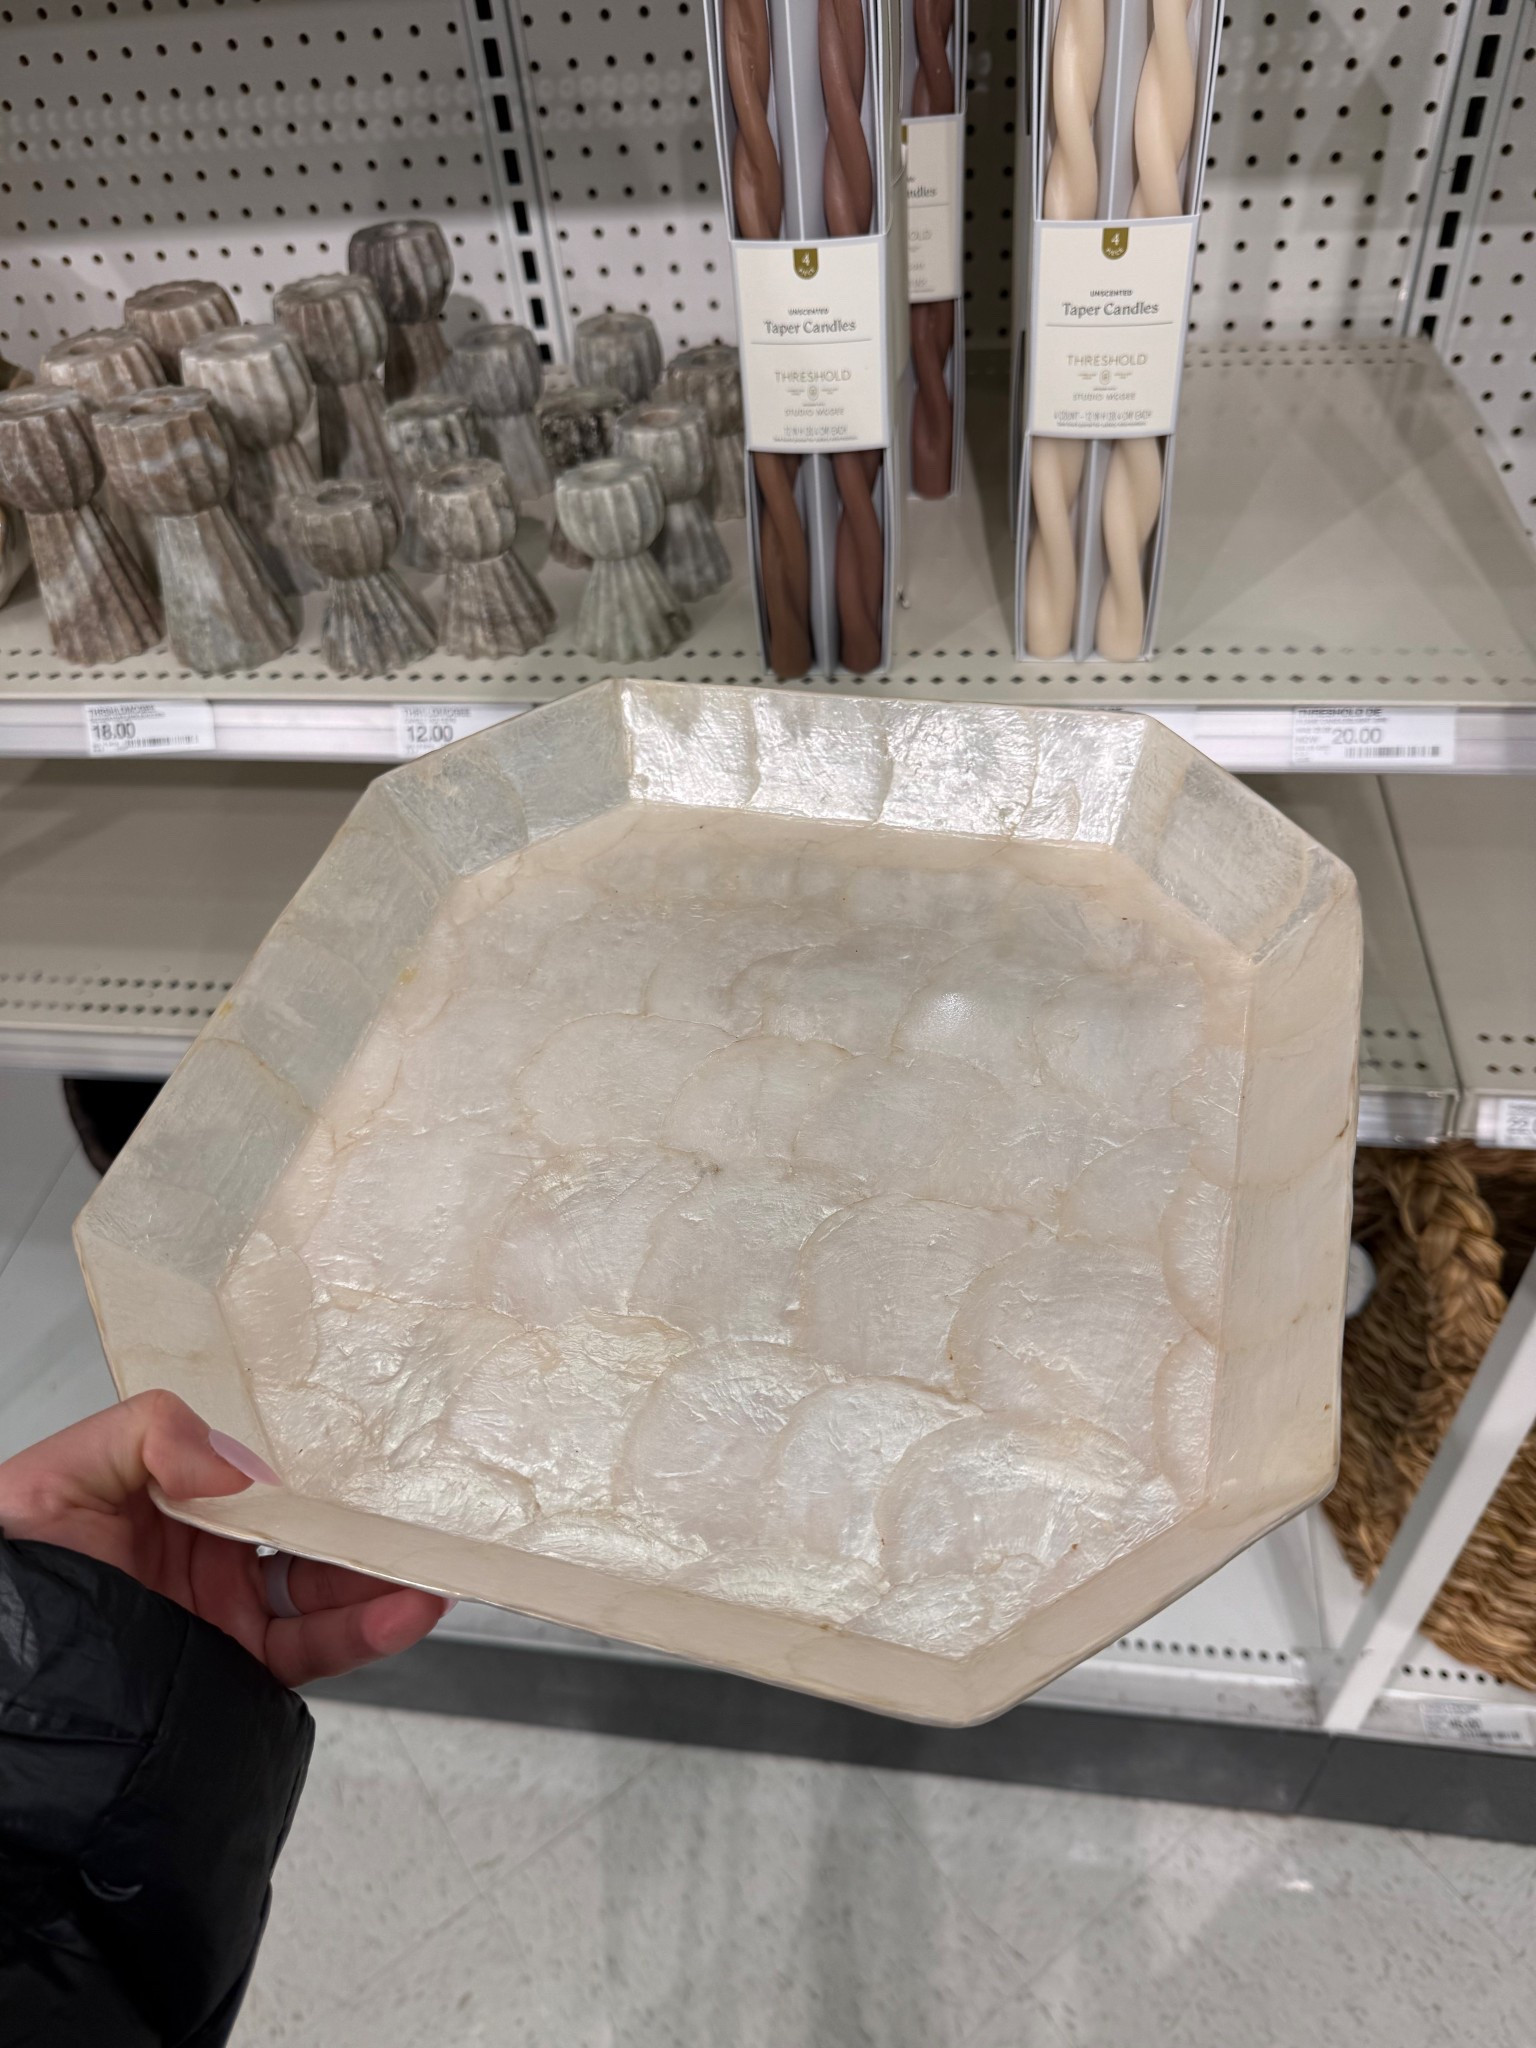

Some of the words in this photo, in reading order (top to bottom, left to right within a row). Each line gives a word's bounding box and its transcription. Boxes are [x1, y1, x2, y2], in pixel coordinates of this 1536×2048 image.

[907, 186, 937, 199] ndles
[1111, 232, 1120, 246] 4
[801, 252, 811, 266] 4
[1089, 289, 1133, 298] UNSCENTED
[1062, 302, 1101, 319] Taper
[1103, 300, 1159, 316] Candles
[763, 320, 800, 336] Taper
[802, 318, 857, 334] Candles
[1067, 353, 1148, 367] THRESHOLD
[774, 369, 853, 384] THRESHOLD
[91, 722, 137, 741] 18.00
[406, 725, 454, 743] 12.00
[1331, 727, 1383, 745] 20.00
